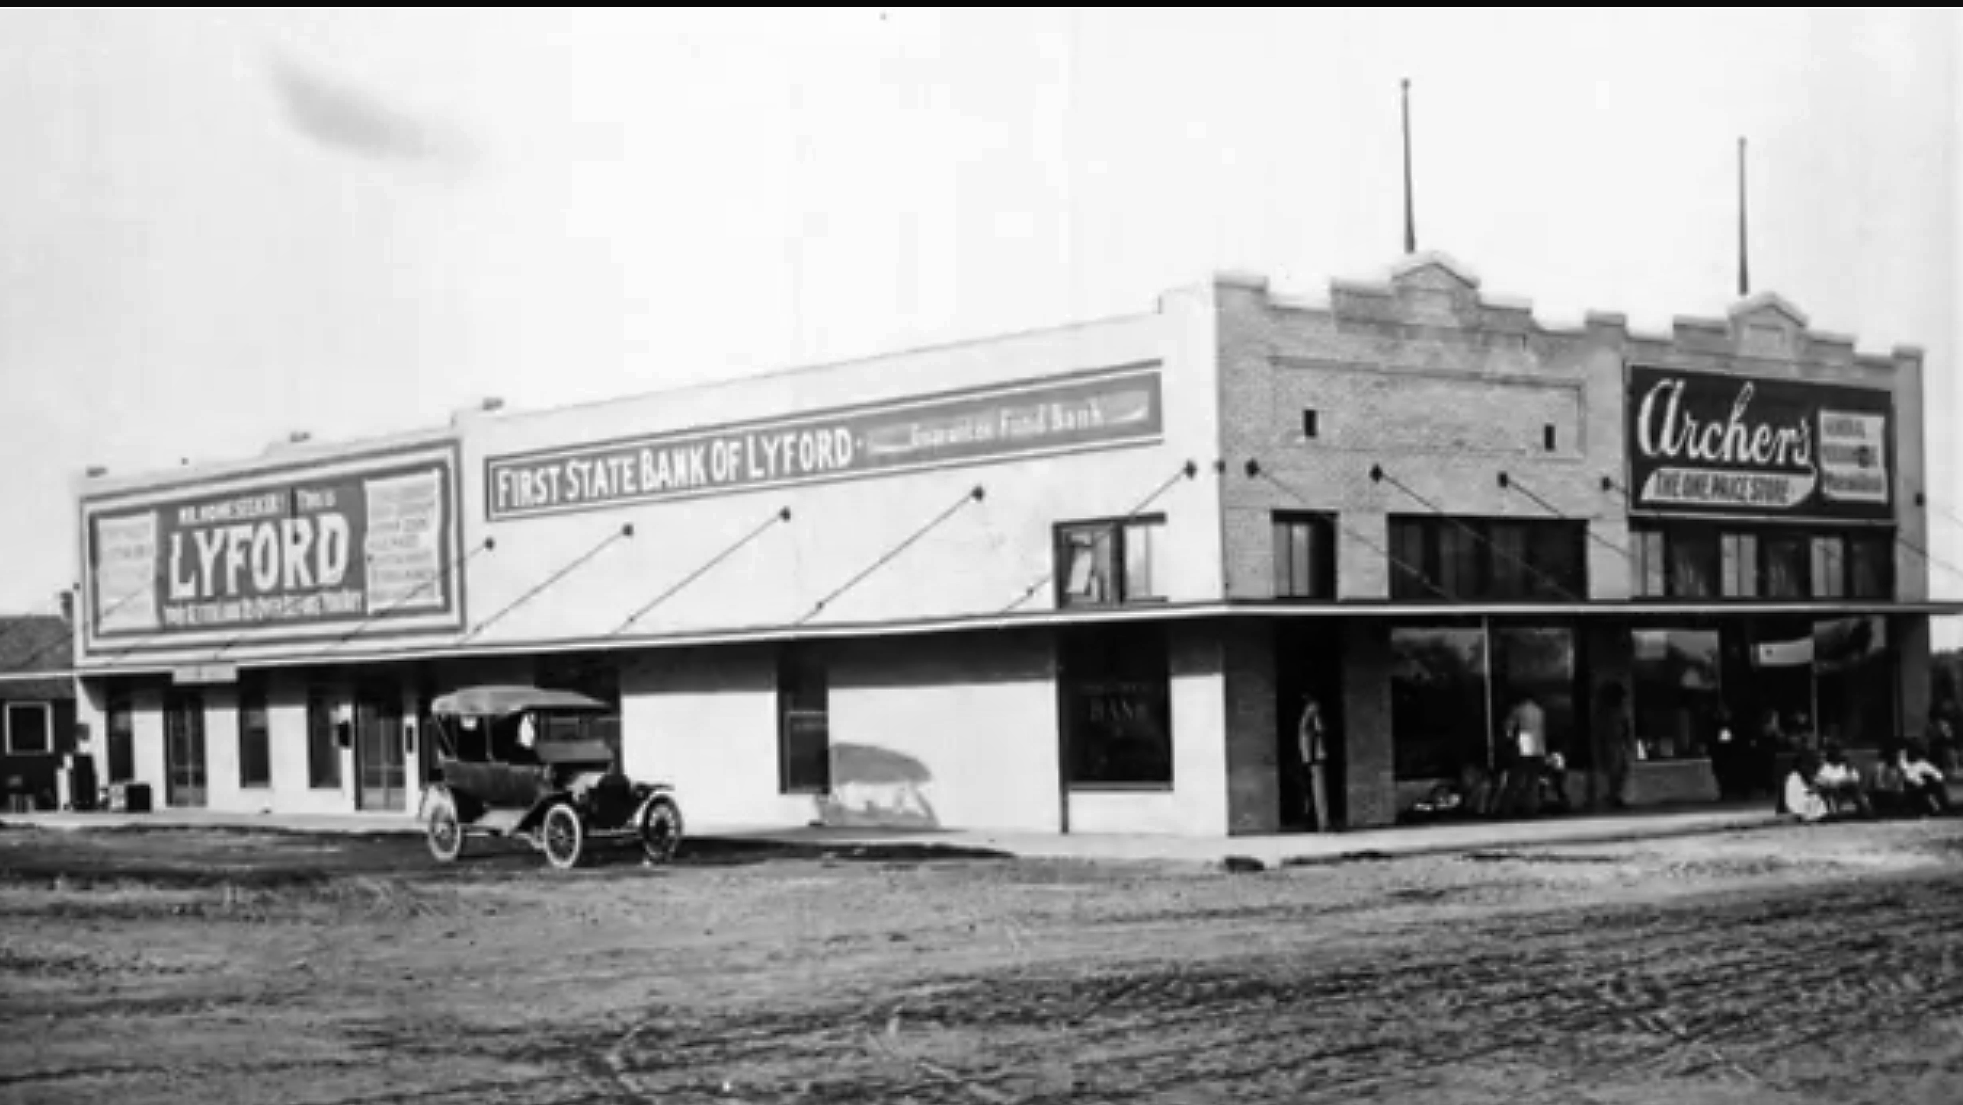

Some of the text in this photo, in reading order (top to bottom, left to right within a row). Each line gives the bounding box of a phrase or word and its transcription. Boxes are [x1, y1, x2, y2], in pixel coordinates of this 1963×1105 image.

[498, 466, 562, 508] FIRST
[564, 457, 638, 501] STATE
[640, 448, 708, 493] BANK
[710, 437, 743, 483] OF
[747, 427, 852, 479] LYFORD
[1051, 396, 1105, 433] Bank
[168, 512, 349, 600] LYFORD
